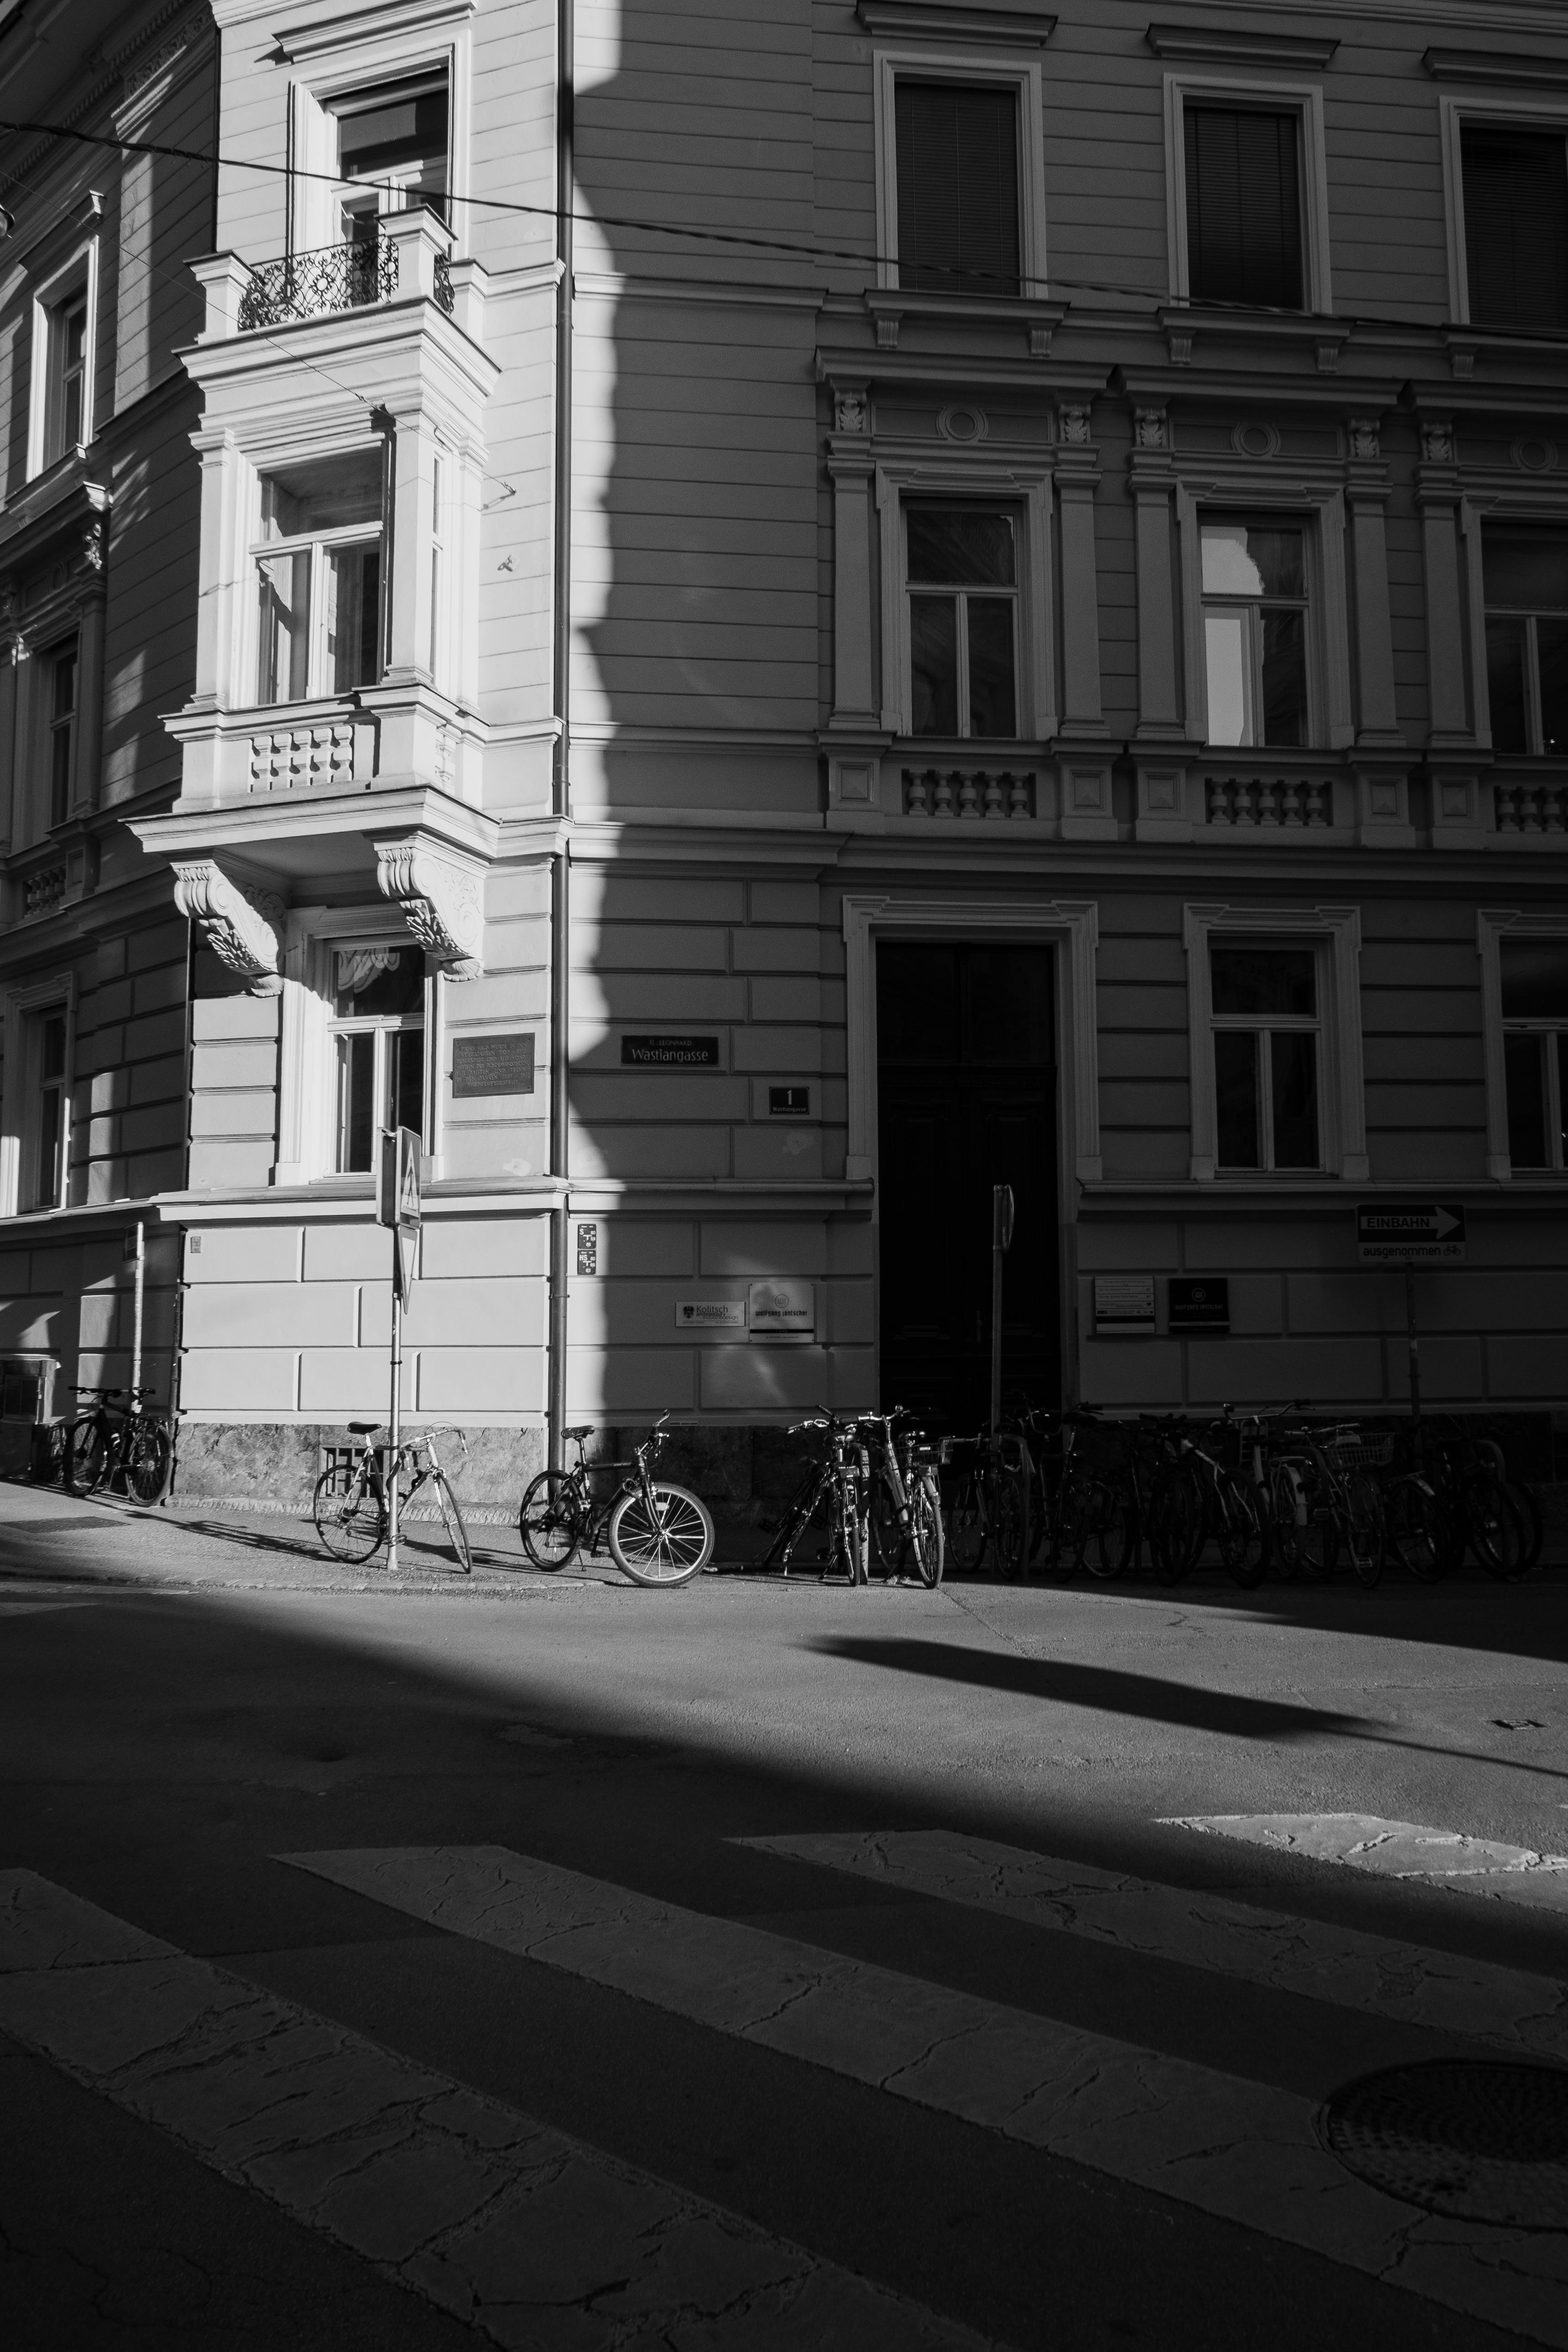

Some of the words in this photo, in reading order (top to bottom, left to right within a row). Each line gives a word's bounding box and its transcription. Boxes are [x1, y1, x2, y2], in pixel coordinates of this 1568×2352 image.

[632, 1048, 708, 1063] Wastiangasse
[787, 1089, 792, 1105] 1
[1367, 1217, 1429, 1228] EINBAHN
[1363, 1248, 1441, 1259] ausgenommen
